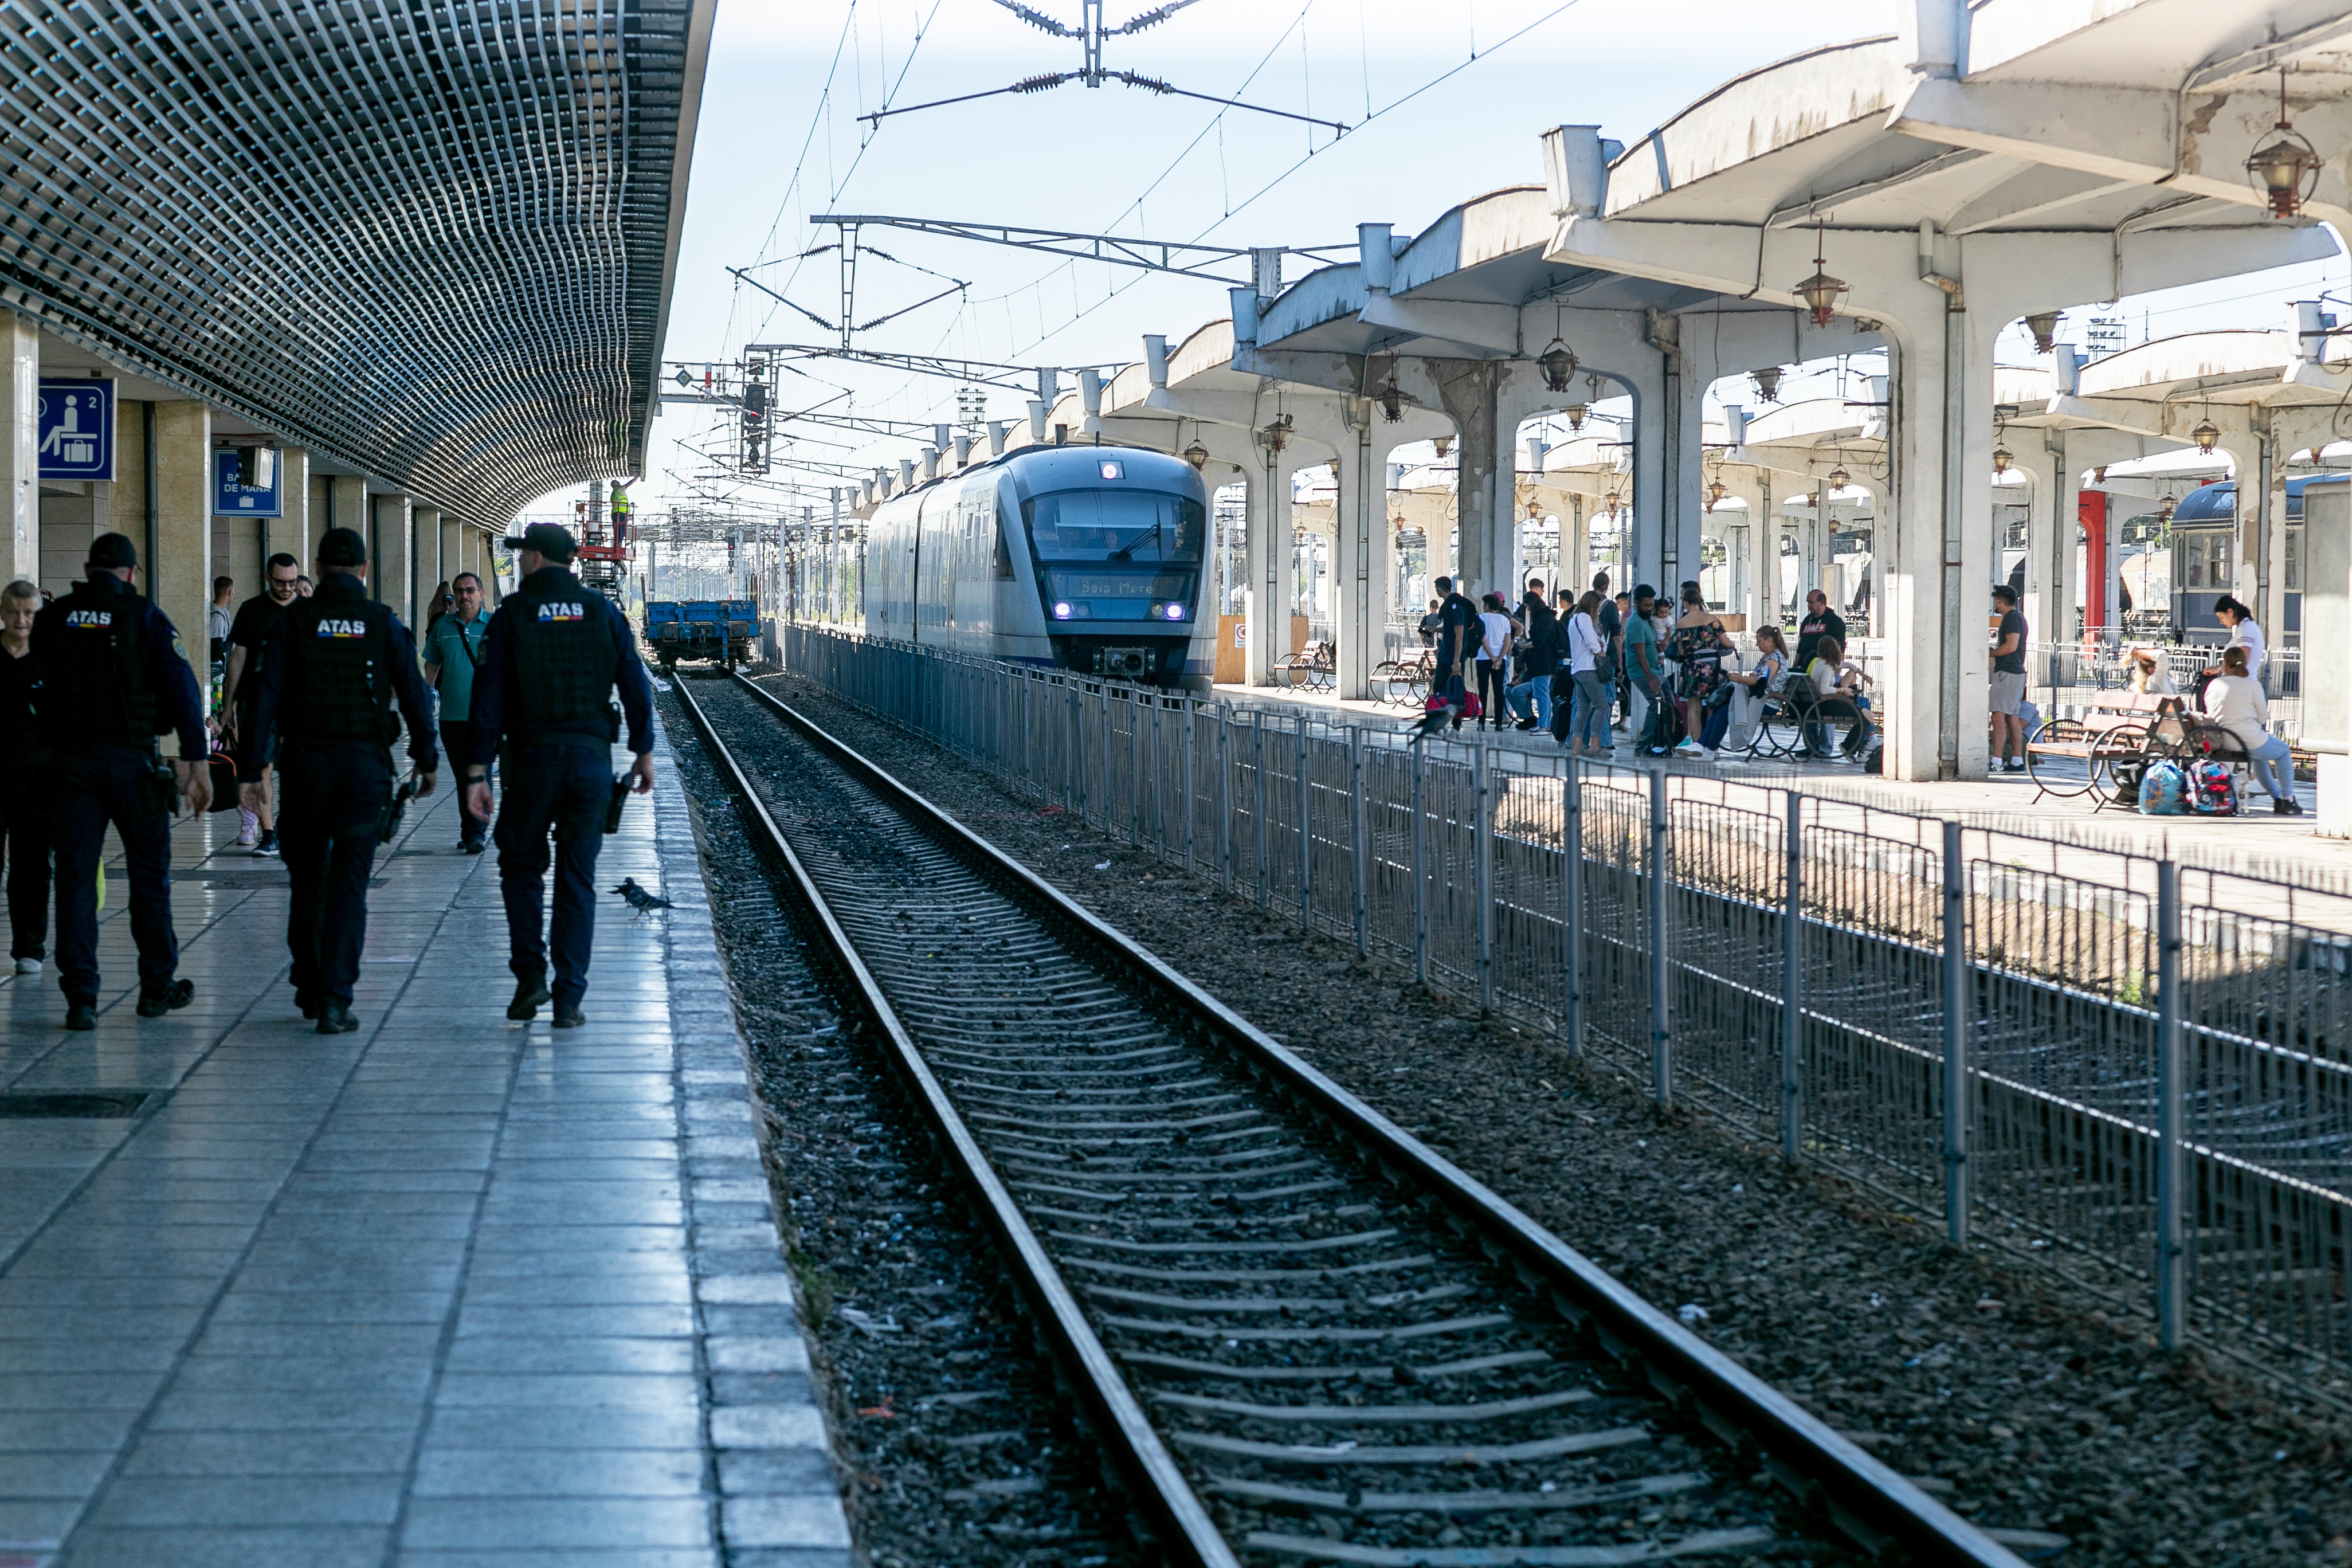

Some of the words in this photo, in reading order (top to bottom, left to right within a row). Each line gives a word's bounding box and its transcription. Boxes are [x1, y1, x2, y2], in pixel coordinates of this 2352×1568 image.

[88, 397, 97, 408] 2
[224, 484, 238, 492] DE
[2204, 537, 2211, 560] 2
[1082, 580, 1111, 594] Baia
[538, 602, 584, 617] ATAS
[66, 610, 112, 625] ATAS
[317, 620, 366, 634] ATAS
